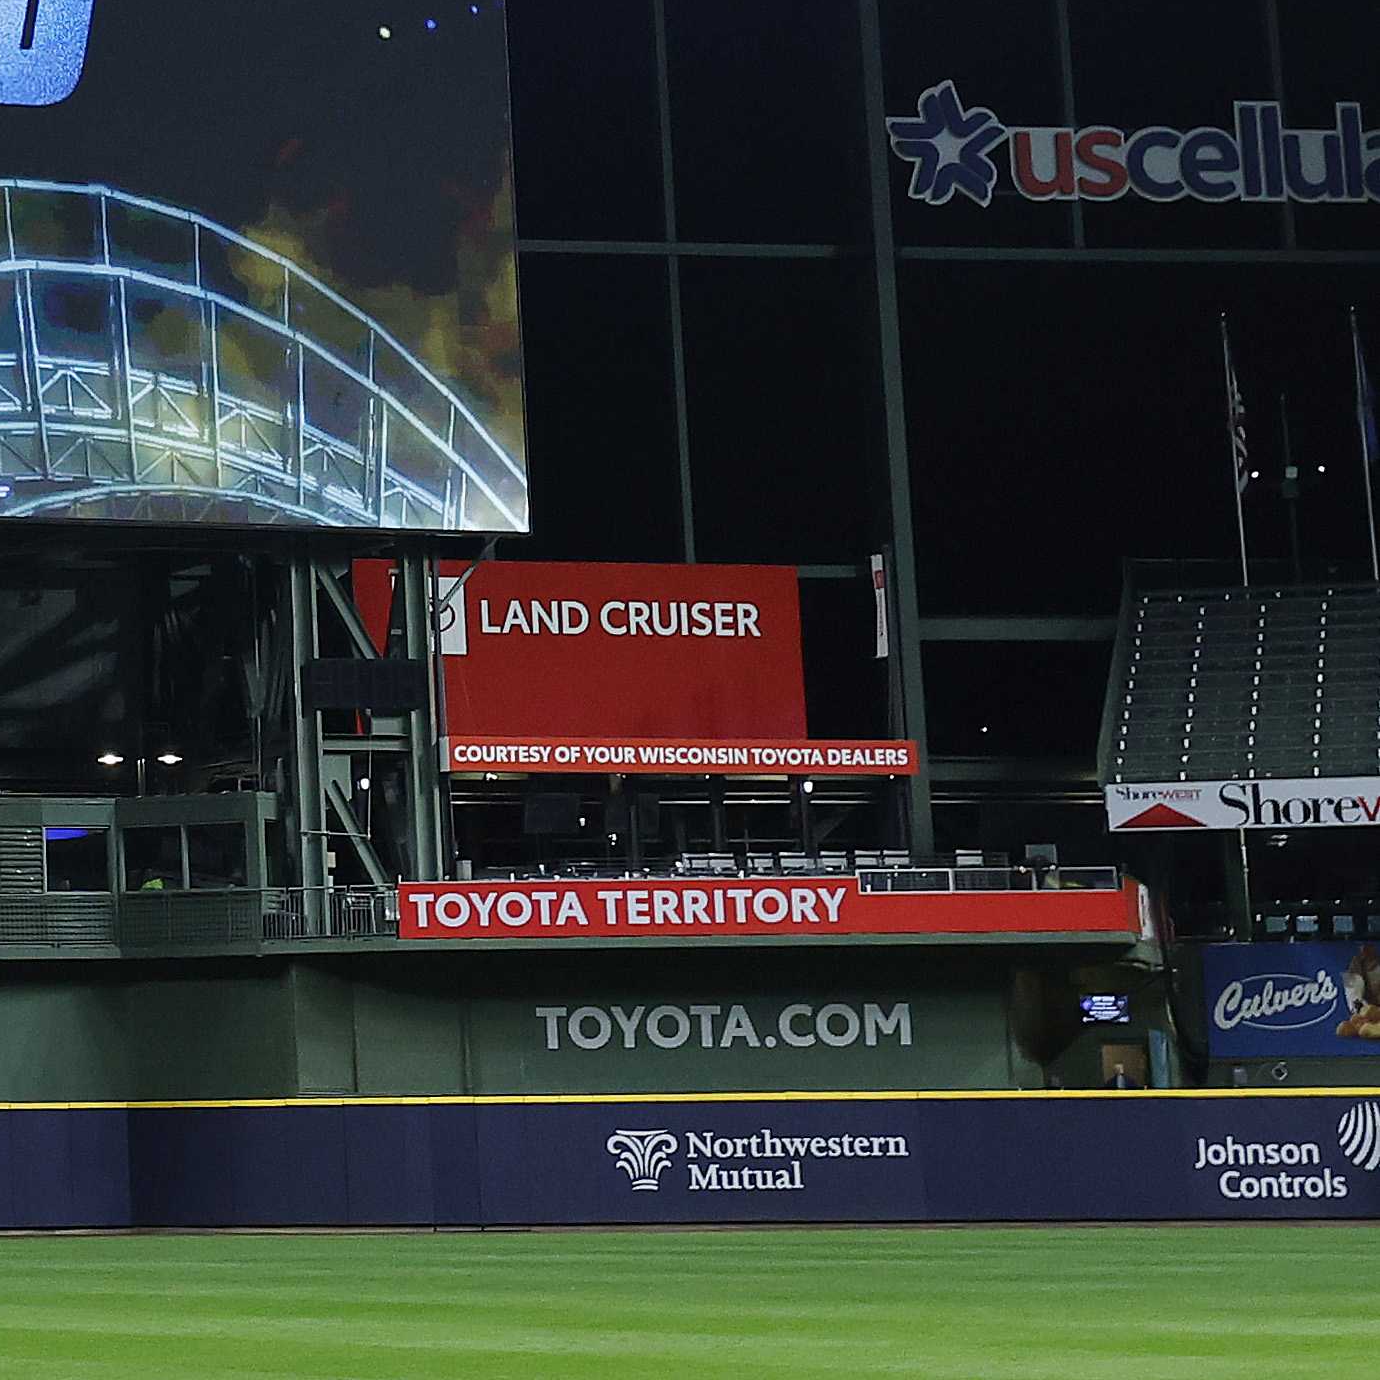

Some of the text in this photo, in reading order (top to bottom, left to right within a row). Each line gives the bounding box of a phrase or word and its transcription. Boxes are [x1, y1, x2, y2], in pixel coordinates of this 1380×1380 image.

[480, 599, 761, 638] LAND CRUISER
[453, 745, 908, 767] COURTESY OF YOUR WISCONSIN TOYOTA DEALERS
[409, 887, 847, 929] TOYOTA TERRITORY
[1213, 970, 1338, 1030] Culver's
[535, 1003, 912, 1051] TOYOTA.COM
[686, 1129, 909, 1159] Northwestern
[1195, 1136, 1320, 1170] Johnson
[688, 1161, 805, 1191] Mutual
[1218, 1168, 1347, 1199] Controls
